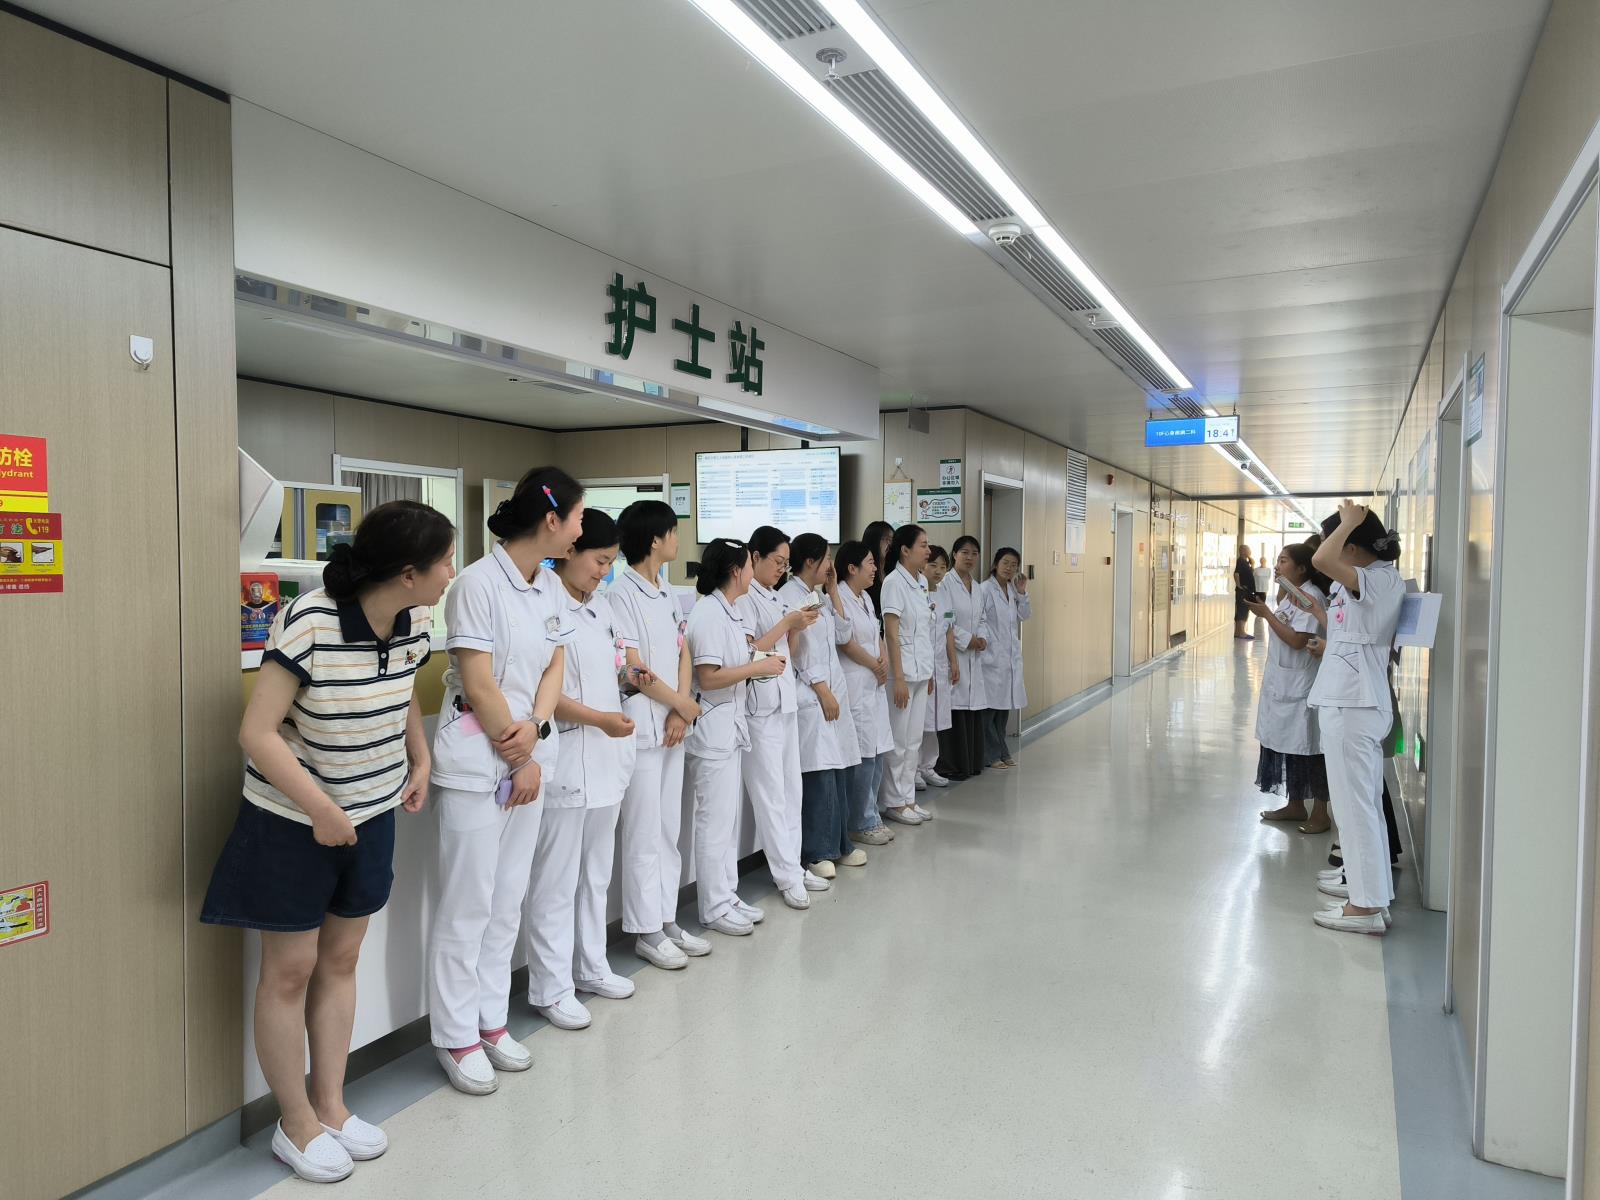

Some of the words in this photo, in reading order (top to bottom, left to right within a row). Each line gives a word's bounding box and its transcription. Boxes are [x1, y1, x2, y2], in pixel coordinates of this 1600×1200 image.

[605, 272, 765, 396] 护士站
[0, 469, 34, 478] ydrant
[38, 526, 49, 534] 119
